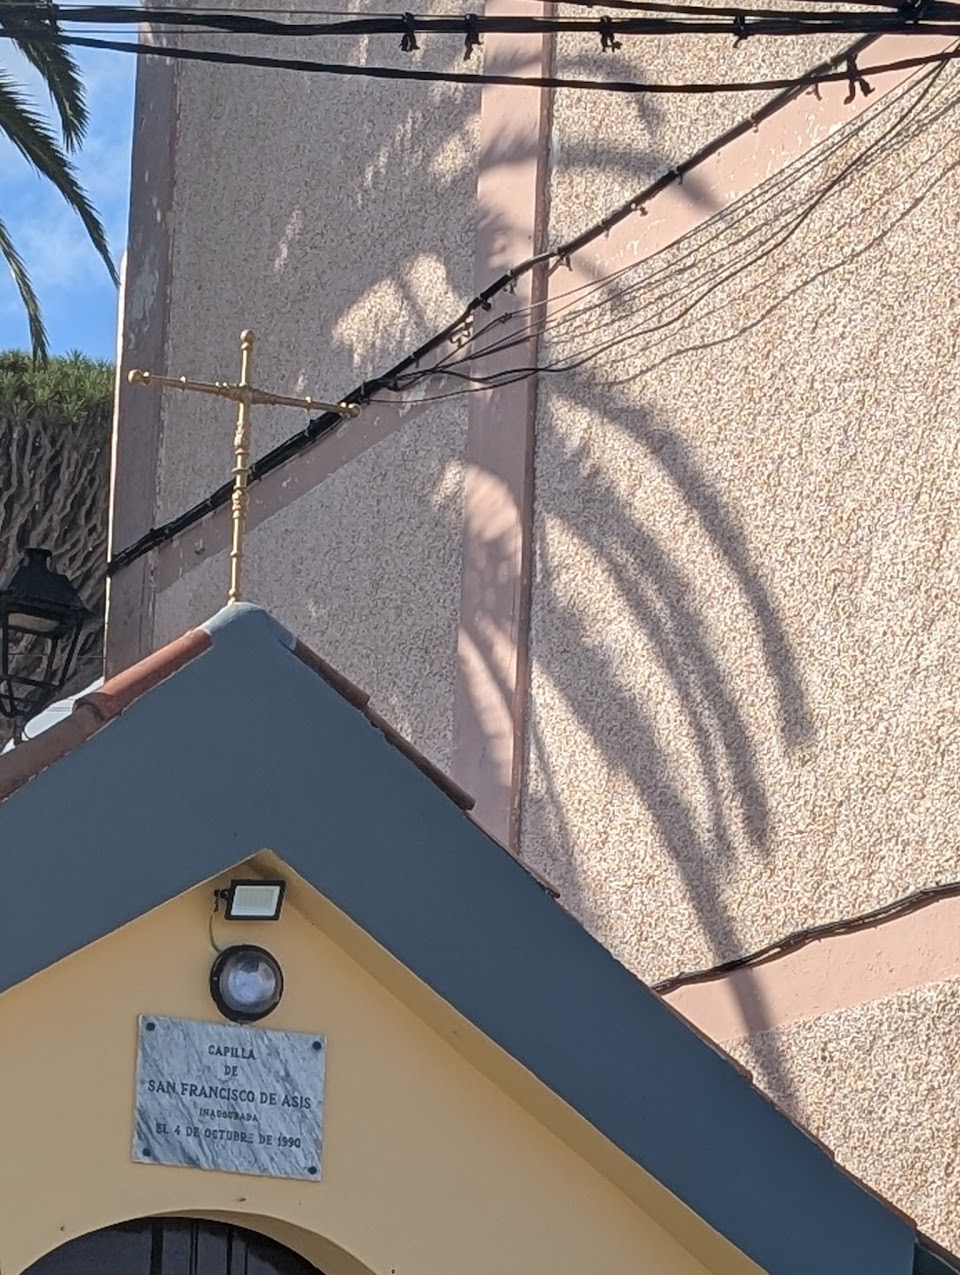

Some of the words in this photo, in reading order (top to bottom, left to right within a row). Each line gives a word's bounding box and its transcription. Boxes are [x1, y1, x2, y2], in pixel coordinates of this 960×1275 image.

[208, 1045, 256, 1060] CAPILLA
[224, 1065, 239, 1077] DE
[147, 1080, 176, 1093] SAN
[181, 1083, 256, 1102] FRANCISCO
[259, 1092, 277, 1105] DE
[281, 1095, 312, 1109] ASIS
[155, 1123, 169, 1135] EL
[174, 1125, 181, 1136] 4
[186, 1127, 200, 1138] DE
[204, 1128, 254, 1144] OCTUBRE
[258, 1135, 273, 1146] DE
[277, 1134, 302, 1148] 1990
